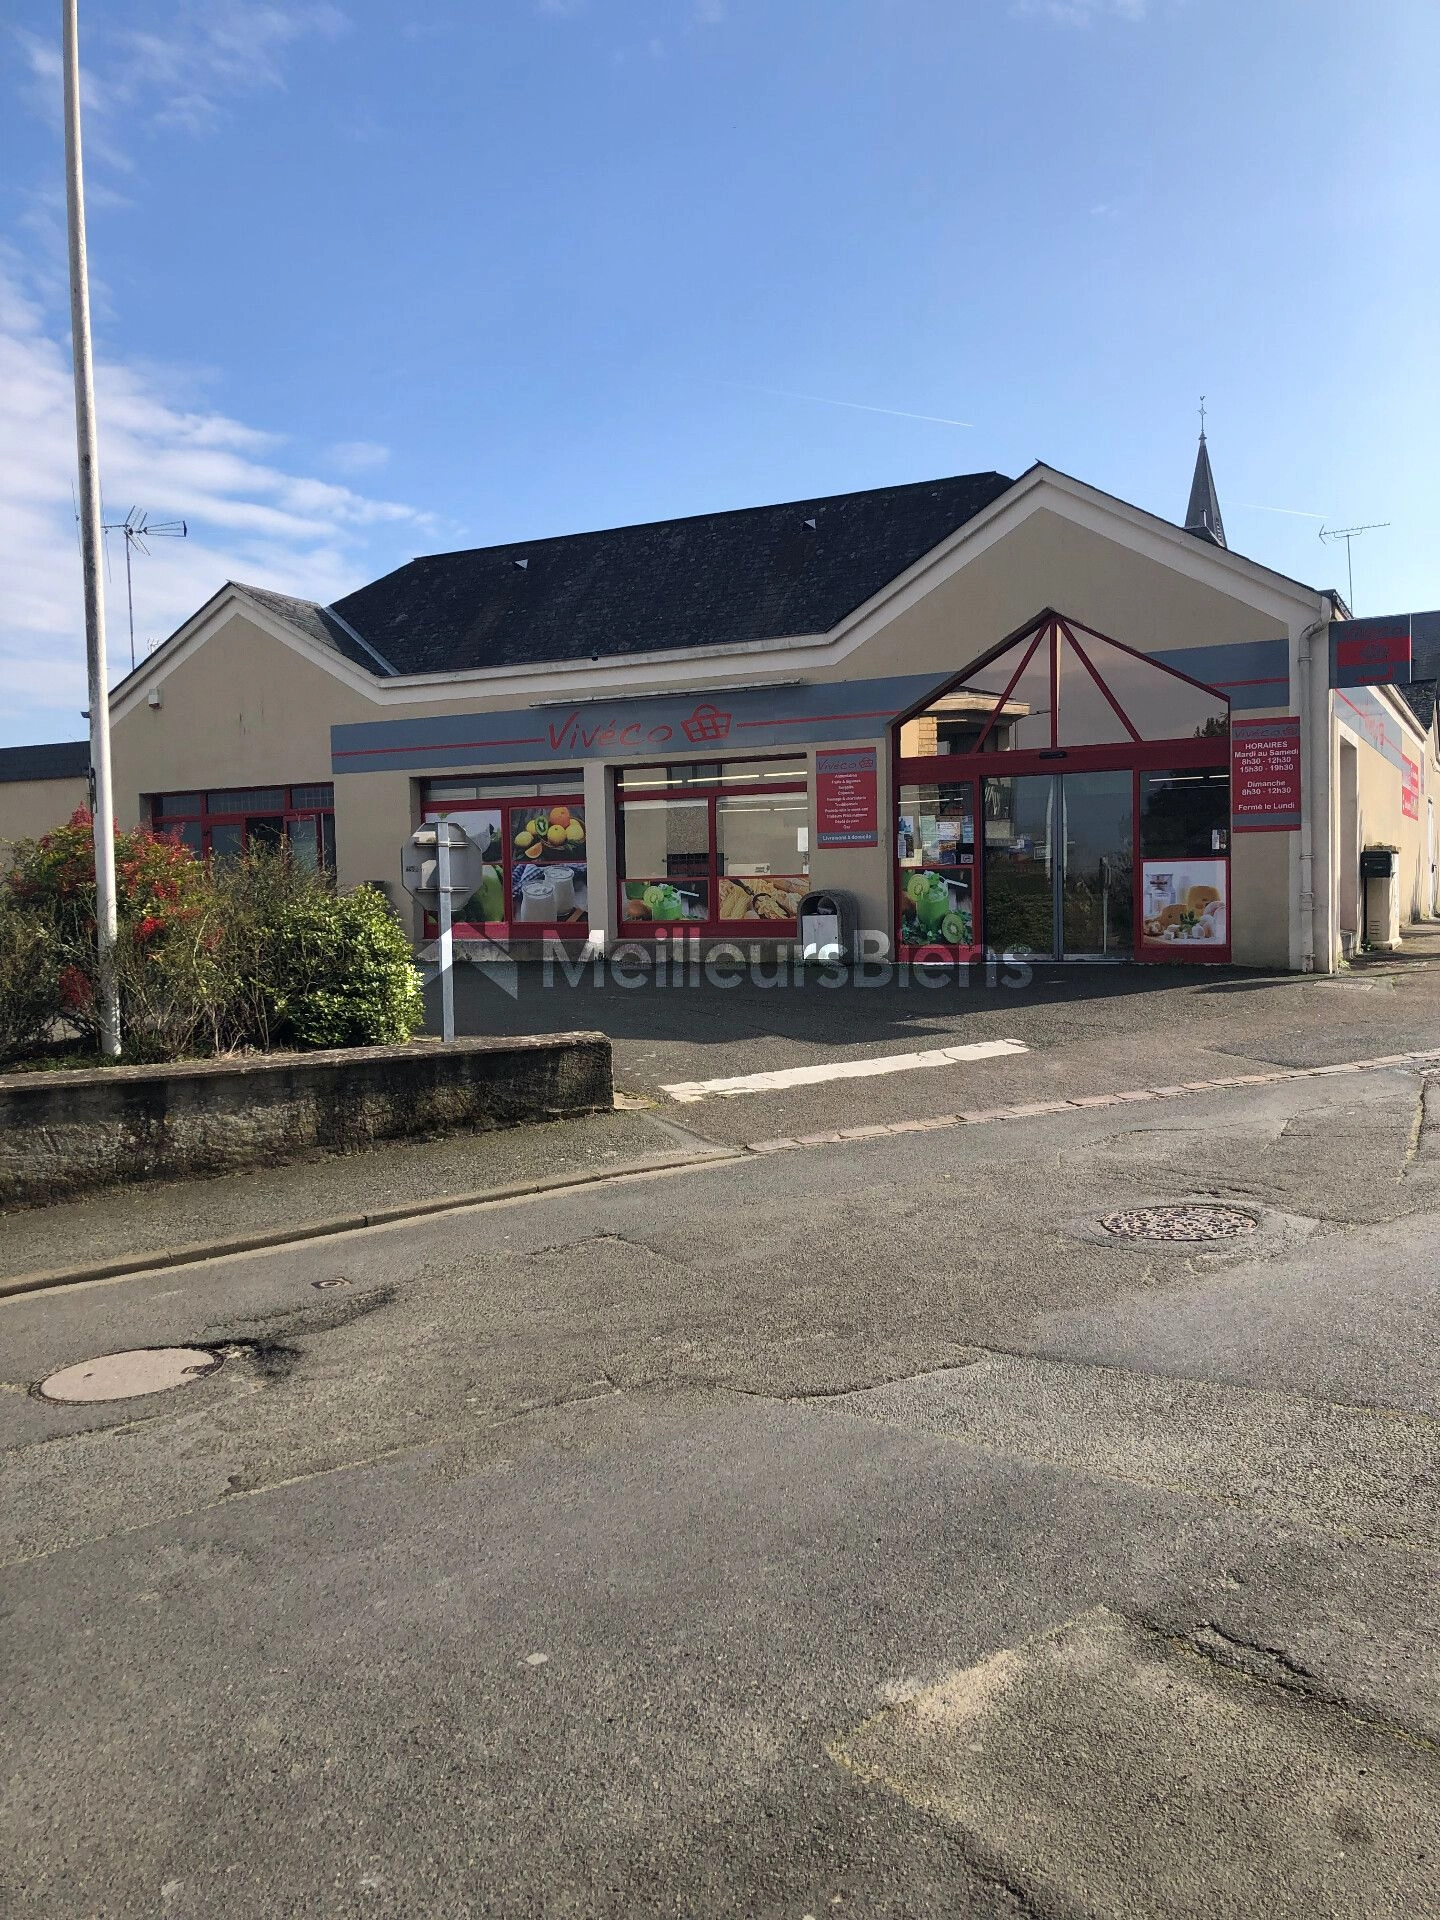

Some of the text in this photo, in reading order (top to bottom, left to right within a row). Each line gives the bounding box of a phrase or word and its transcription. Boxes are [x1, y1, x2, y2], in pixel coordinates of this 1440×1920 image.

[548, 710, 673, 750] Vivéco
[1245, 741, 1288, 750] HORAIRES
[1247, 780, 1286, 788] Dimanche
[1241, 788, 1261, 796] 8h30
[1238, 803, 1263, 811] Fermé
